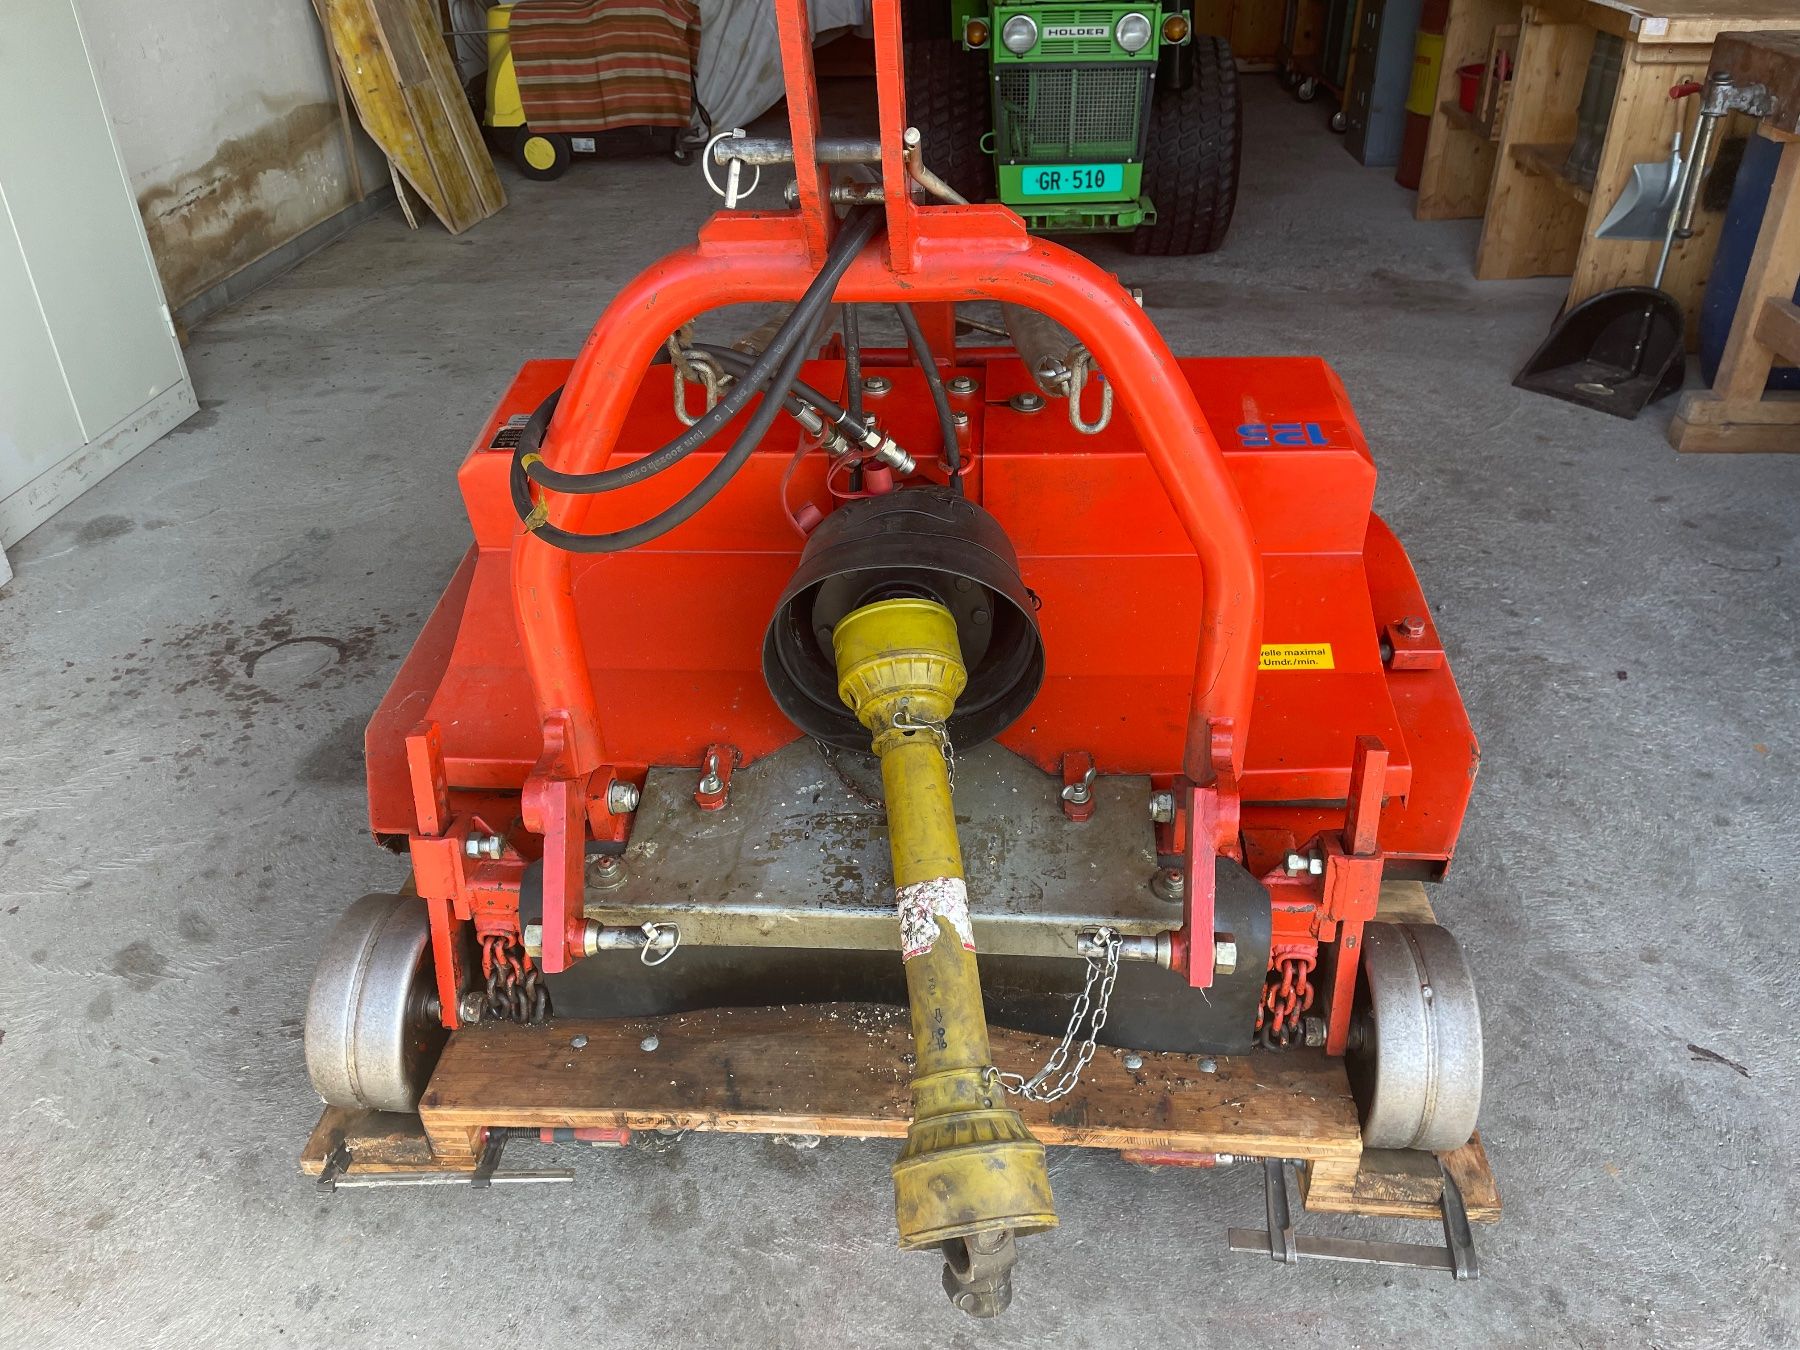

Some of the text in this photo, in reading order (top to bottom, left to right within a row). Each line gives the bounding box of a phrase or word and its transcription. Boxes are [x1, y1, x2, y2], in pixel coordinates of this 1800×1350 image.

[1048, 28, 1104, 36] HOLDER
[1039, 169, 1105, 191] GR 510
[1236, 422, 1329, 446] 125
[1284, 648, 1326, 656] maximal
[1263, 658, 1319, 666] Umdr./min.
